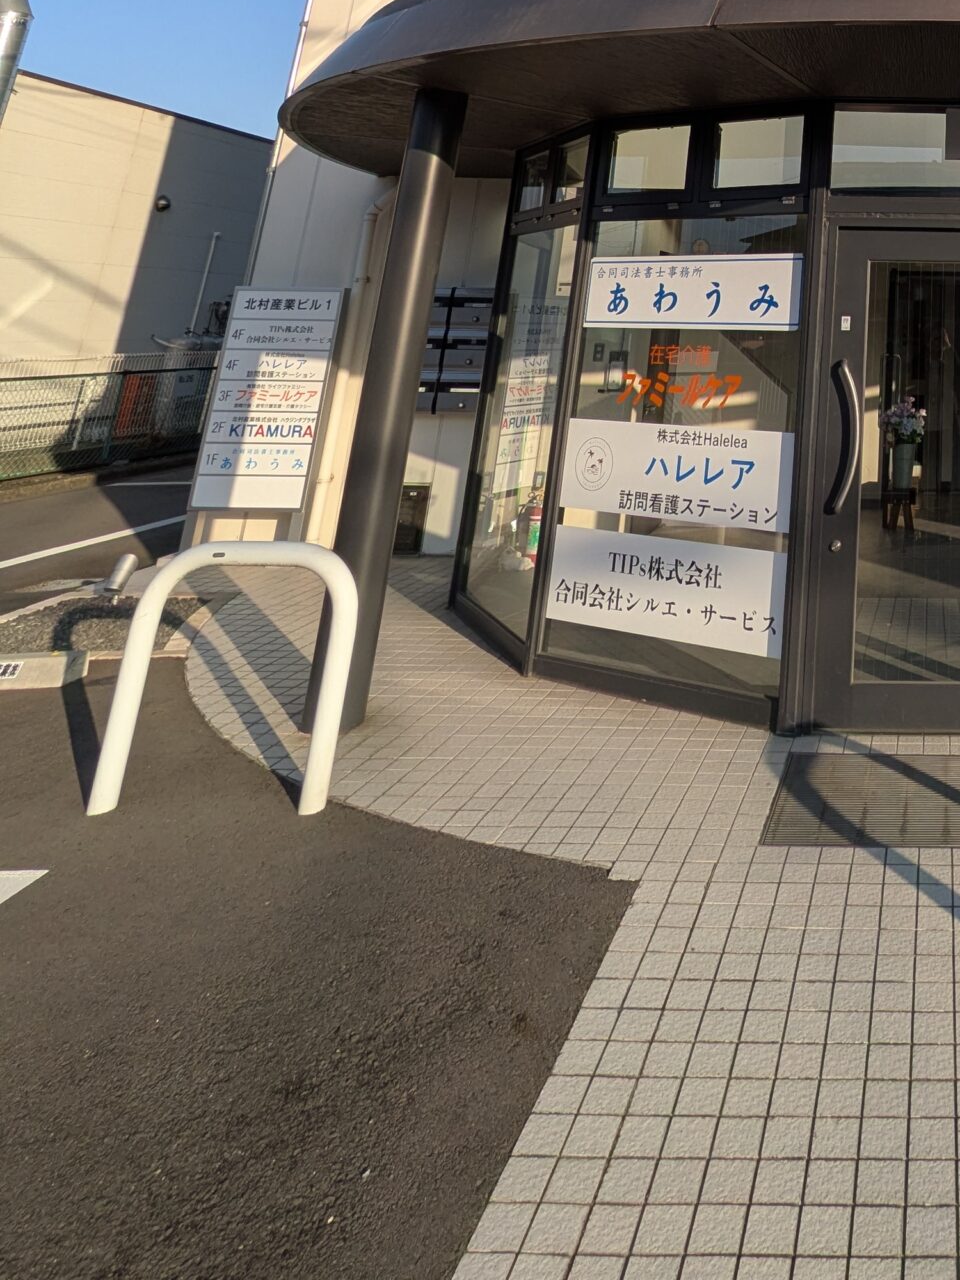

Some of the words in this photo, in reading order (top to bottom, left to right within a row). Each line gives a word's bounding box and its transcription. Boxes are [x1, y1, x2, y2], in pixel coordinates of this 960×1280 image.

[596, 265, 704, 279] 合同司法書士事務所
[606, 282, 780, 317] あわうみ
[231, 328, 246, 340] 4F
[649, 344, 712, 367] 在宅介護
[225, 359, 240, 371] 4F
[258, 359, 308, 370] ハレレア
[218, 390, 233, 402] 3F
[235, 389, 319, 402] ファミールケア
[614, 371, 743, 409] ファミールケア
[211, 421, 227, 434] 2F
[228, 423, 314, 439] KITAMURA
[656, 427, 748, 449] 株式会社Halelea
[205, 453, 220, 466] 1F
[219, 457, 304, 471] あわうみ
[643, 456, 756, 490] ハレレア
[618, 489, 779, 525] 訪問看護ステーション
[607, 551, 723, 590] TIPs株式会社
[553, 577, 779, 636] 合同会社シルエ・サービス
